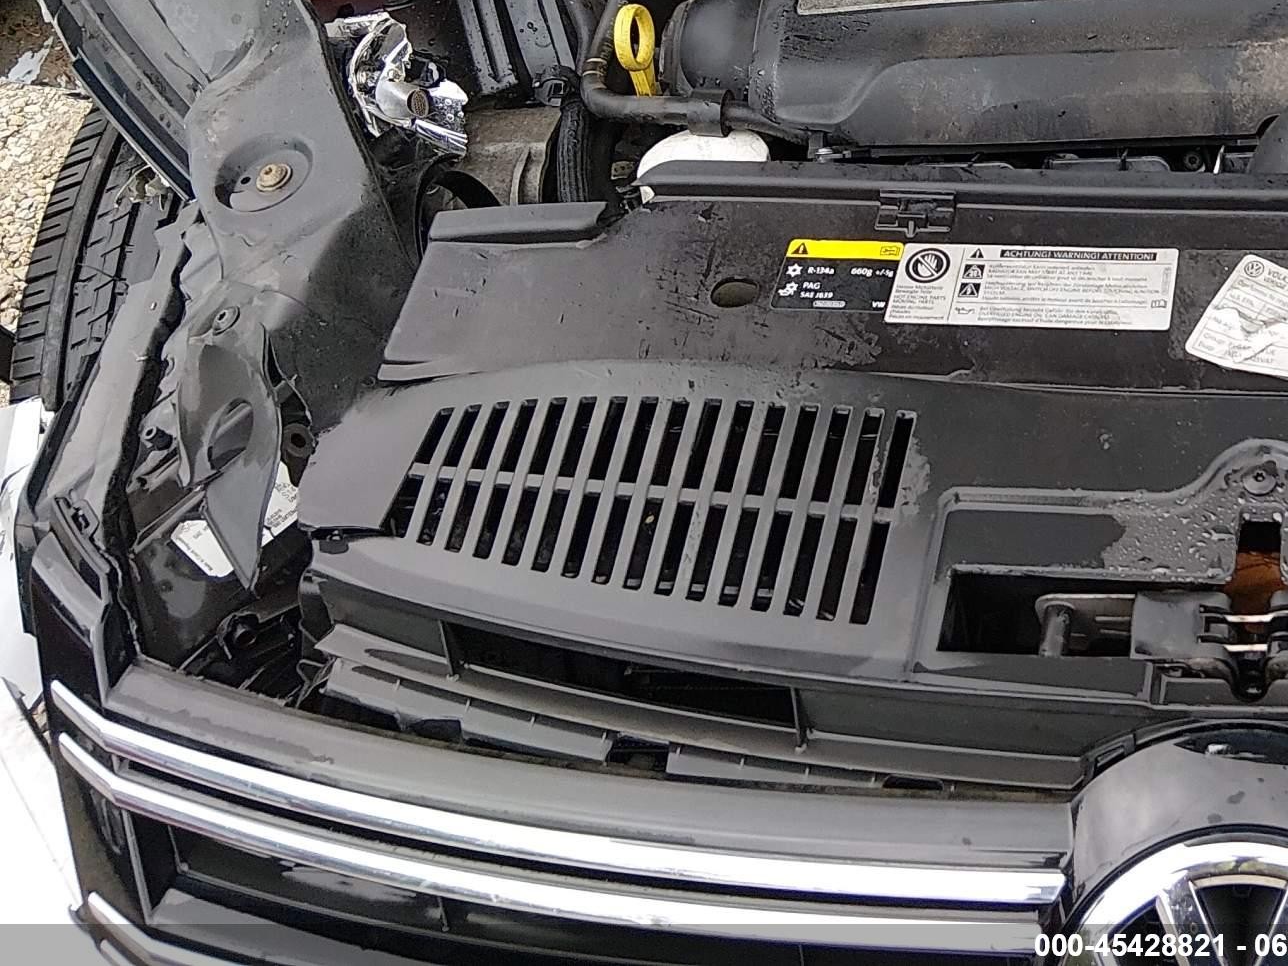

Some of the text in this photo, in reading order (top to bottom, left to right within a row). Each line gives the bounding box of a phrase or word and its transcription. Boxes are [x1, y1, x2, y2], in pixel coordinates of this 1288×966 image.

[1003, 249, 1154, 261] ACHTUNG! WARNING! ATTENTION!
[807, 266, 835, 275] R-134a
[850, 267, 873, 277] 660g
[802, 281, 821, 290] PAG
[800, 290, 814, 299] SAE
[872, 300, 886, 309] VW
